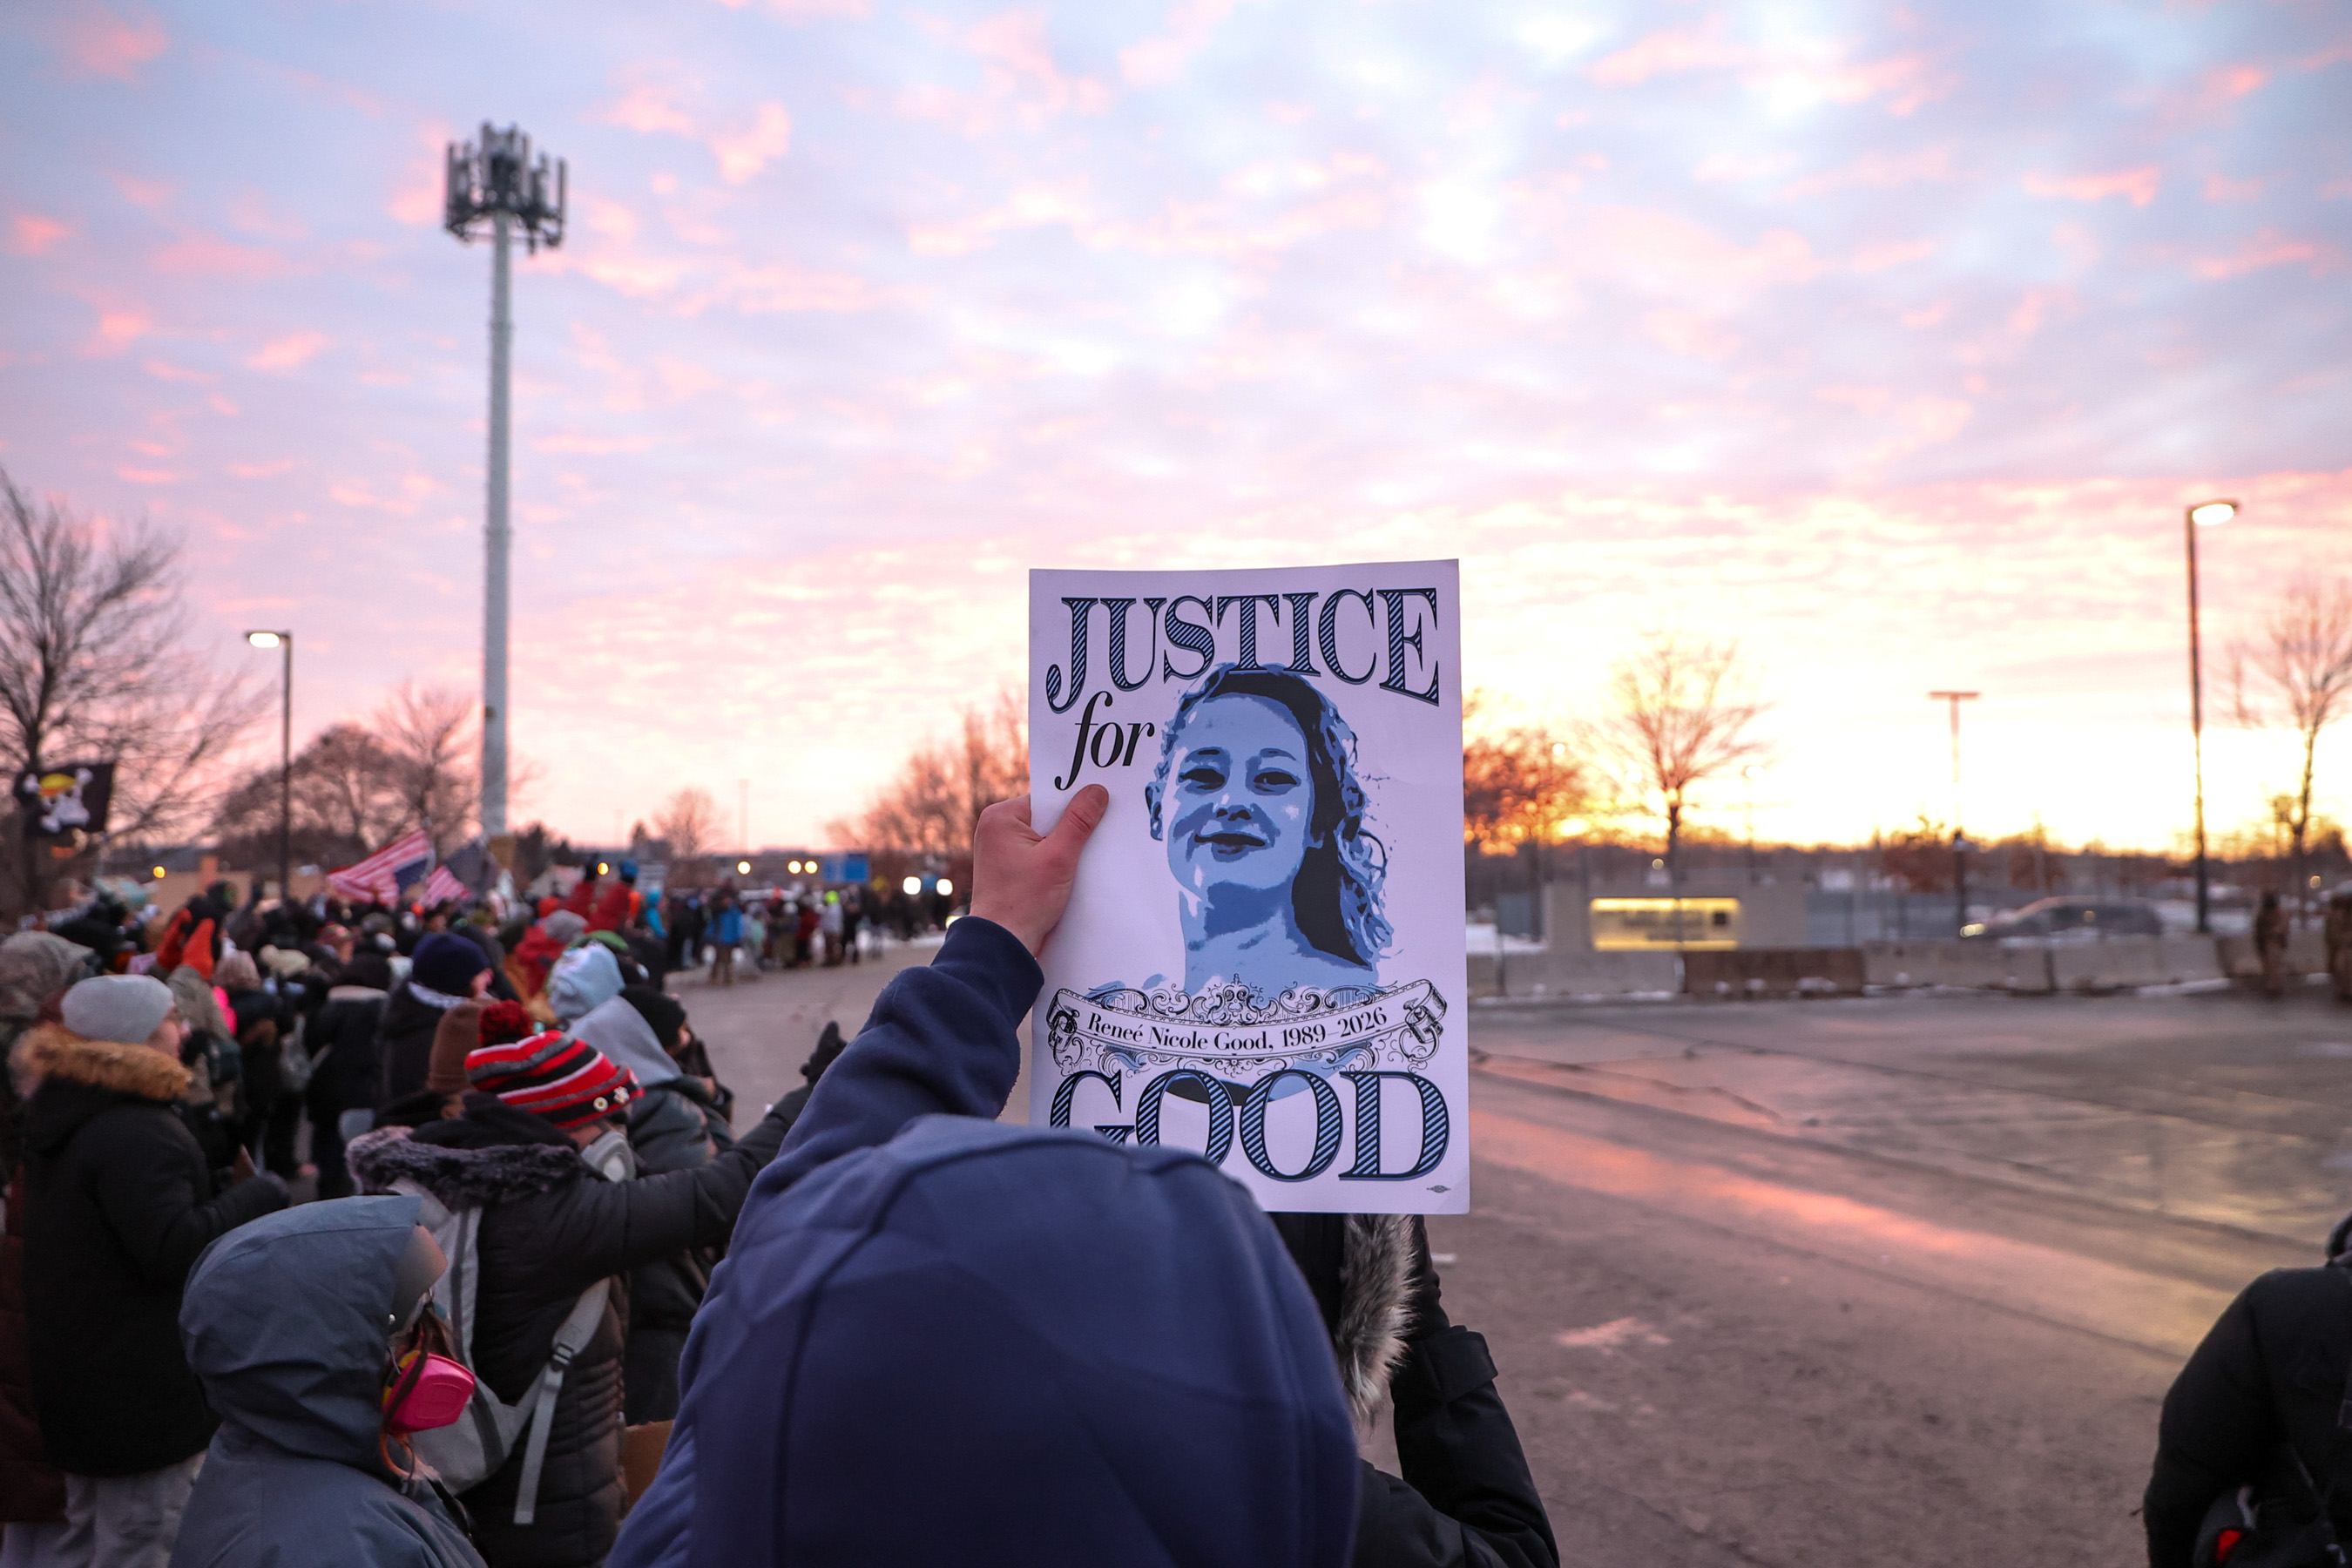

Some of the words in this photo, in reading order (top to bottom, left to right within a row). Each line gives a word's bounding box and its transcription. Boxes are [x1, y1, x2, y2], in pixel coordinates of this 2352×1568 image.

[1046, 587, 1439, 713] JUSTICE
[1054, 691, 1155, 791] for
[1087, 1012, 1144, 1042] Reneé
[1148, 1026, 1208, 1050] Nicole
[1213, 1029, 1274, 1052] Good,
[1049, 1068, 1450, 1182] GOOD
